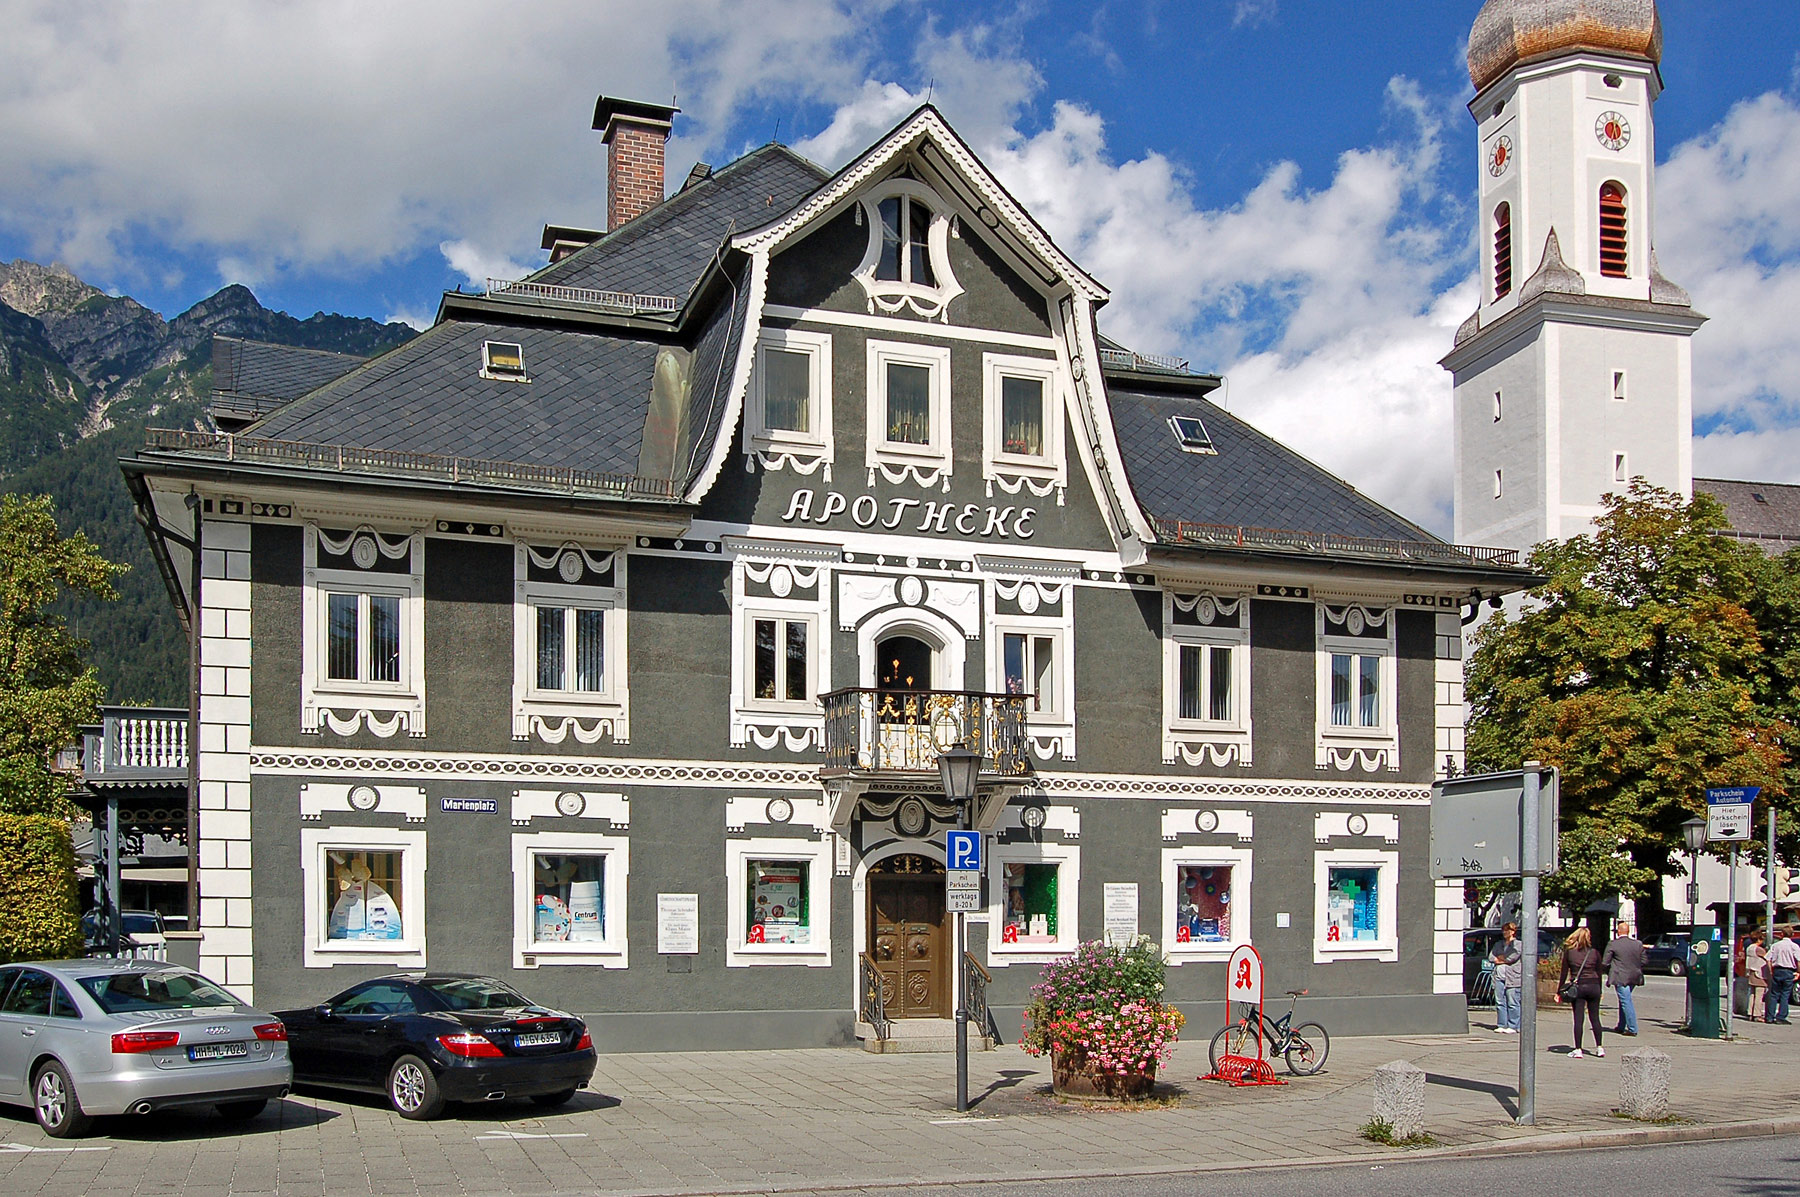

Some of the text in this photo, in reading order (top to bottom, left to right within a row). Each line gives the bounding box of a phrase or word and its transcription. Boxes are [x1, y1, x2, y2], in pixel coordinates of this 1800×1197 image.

[781, 488, 1037, 539] APOTHEKE
[443, 799, 495, 811] Marienplatz
[1710, 813, 1748, 821] Parkschein
[954, 836, 973, 868] P
[950, 892, 977, 901] werktags
[541, 1032, 559, 1042] 6354
[225, 1042, 246, 1055] 7028
